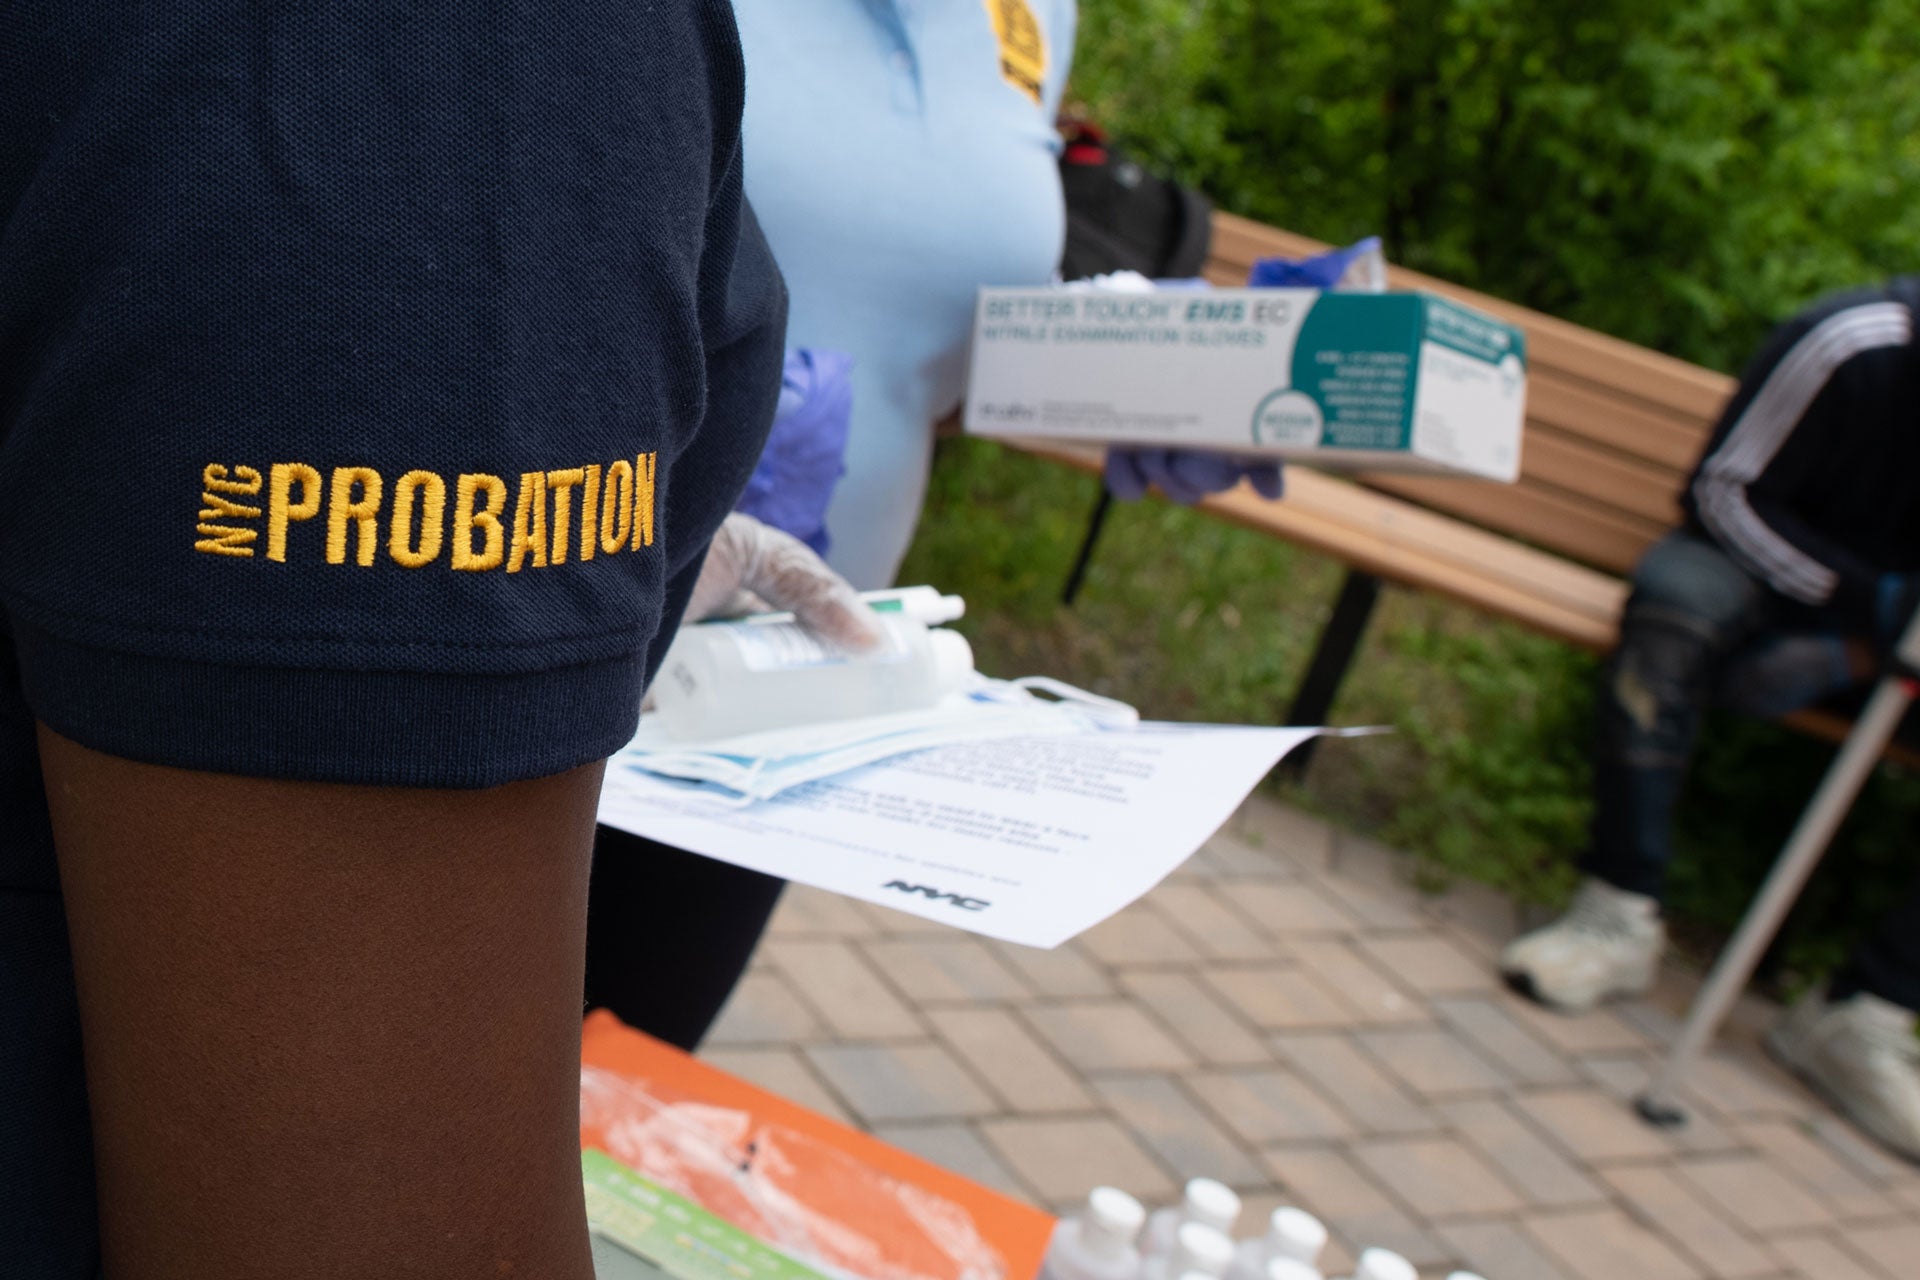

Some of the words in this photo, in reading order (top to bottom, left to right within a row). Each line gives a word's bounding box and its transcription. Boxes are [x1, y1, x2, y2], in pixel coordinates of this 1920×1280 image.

[984, 299, 1076, 319] BETTER
[1083, 300, 1169, 321] TOUCH
[1185, 301, 1245, 322] EMS
[1253, 302, 1291, 324] EC
[195, 462, 262, 557] NYC
[266, 450, 658, 574] PROBATION
